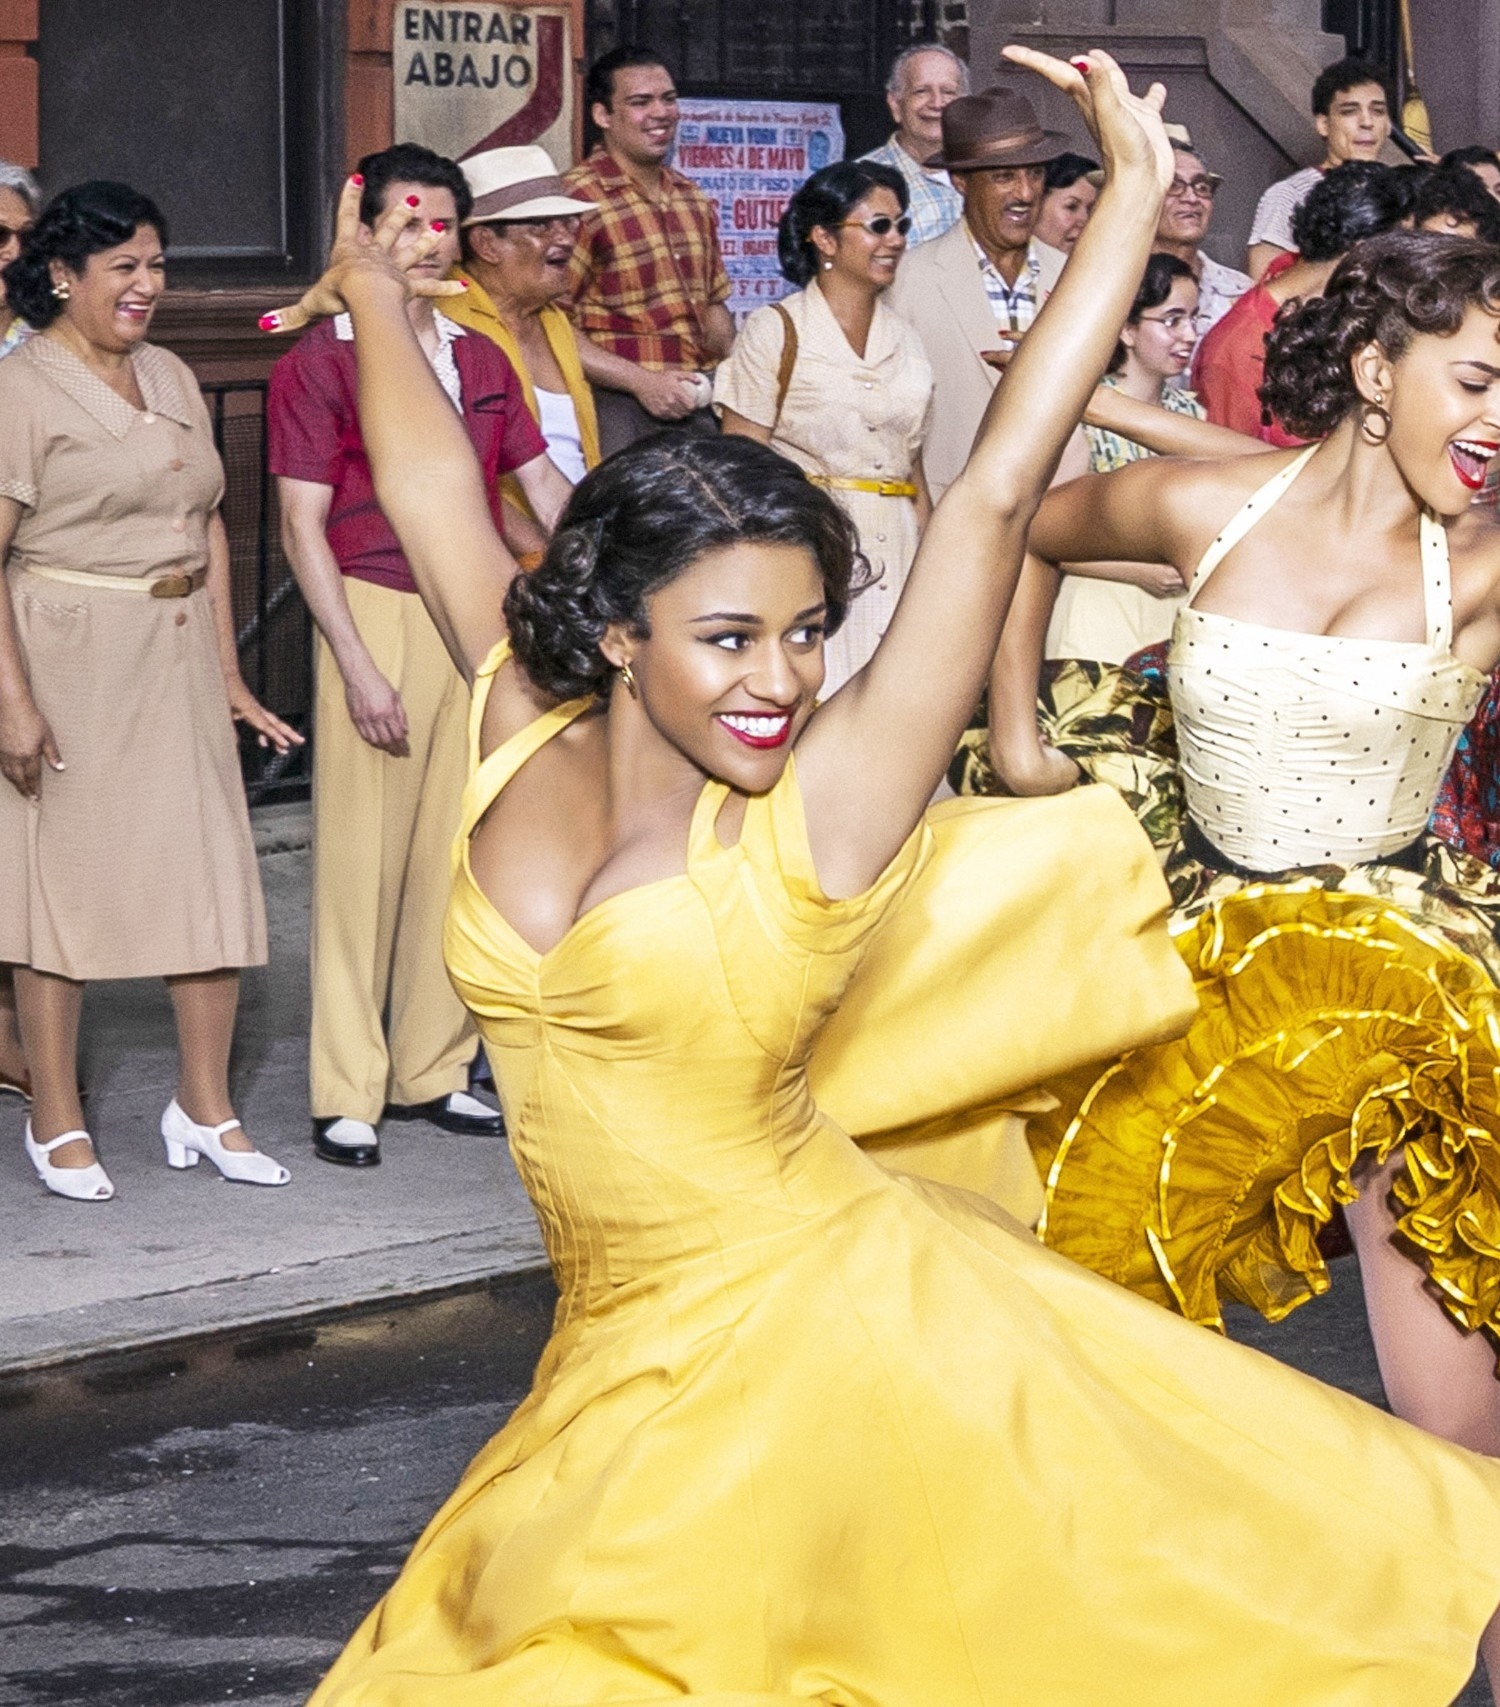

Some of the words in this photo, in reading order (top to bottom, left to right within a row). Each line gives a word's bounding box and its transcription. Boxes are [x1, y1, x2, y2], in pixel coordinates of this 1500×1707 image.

[405, 8, 531, 45] ENTRAR
[404, 52, 531, 88] ABAJO
[707, 127, 743, 143] NUEVA
[747, 128, 776, 144] YORK
[678, 145, 733, 168] VIERNES
[735, 147, 744, 169] 4
[748, 148, 764, 170] DE
[767, 148, 805, 171] MAYO
[758, 178, 790, 192] PESO
